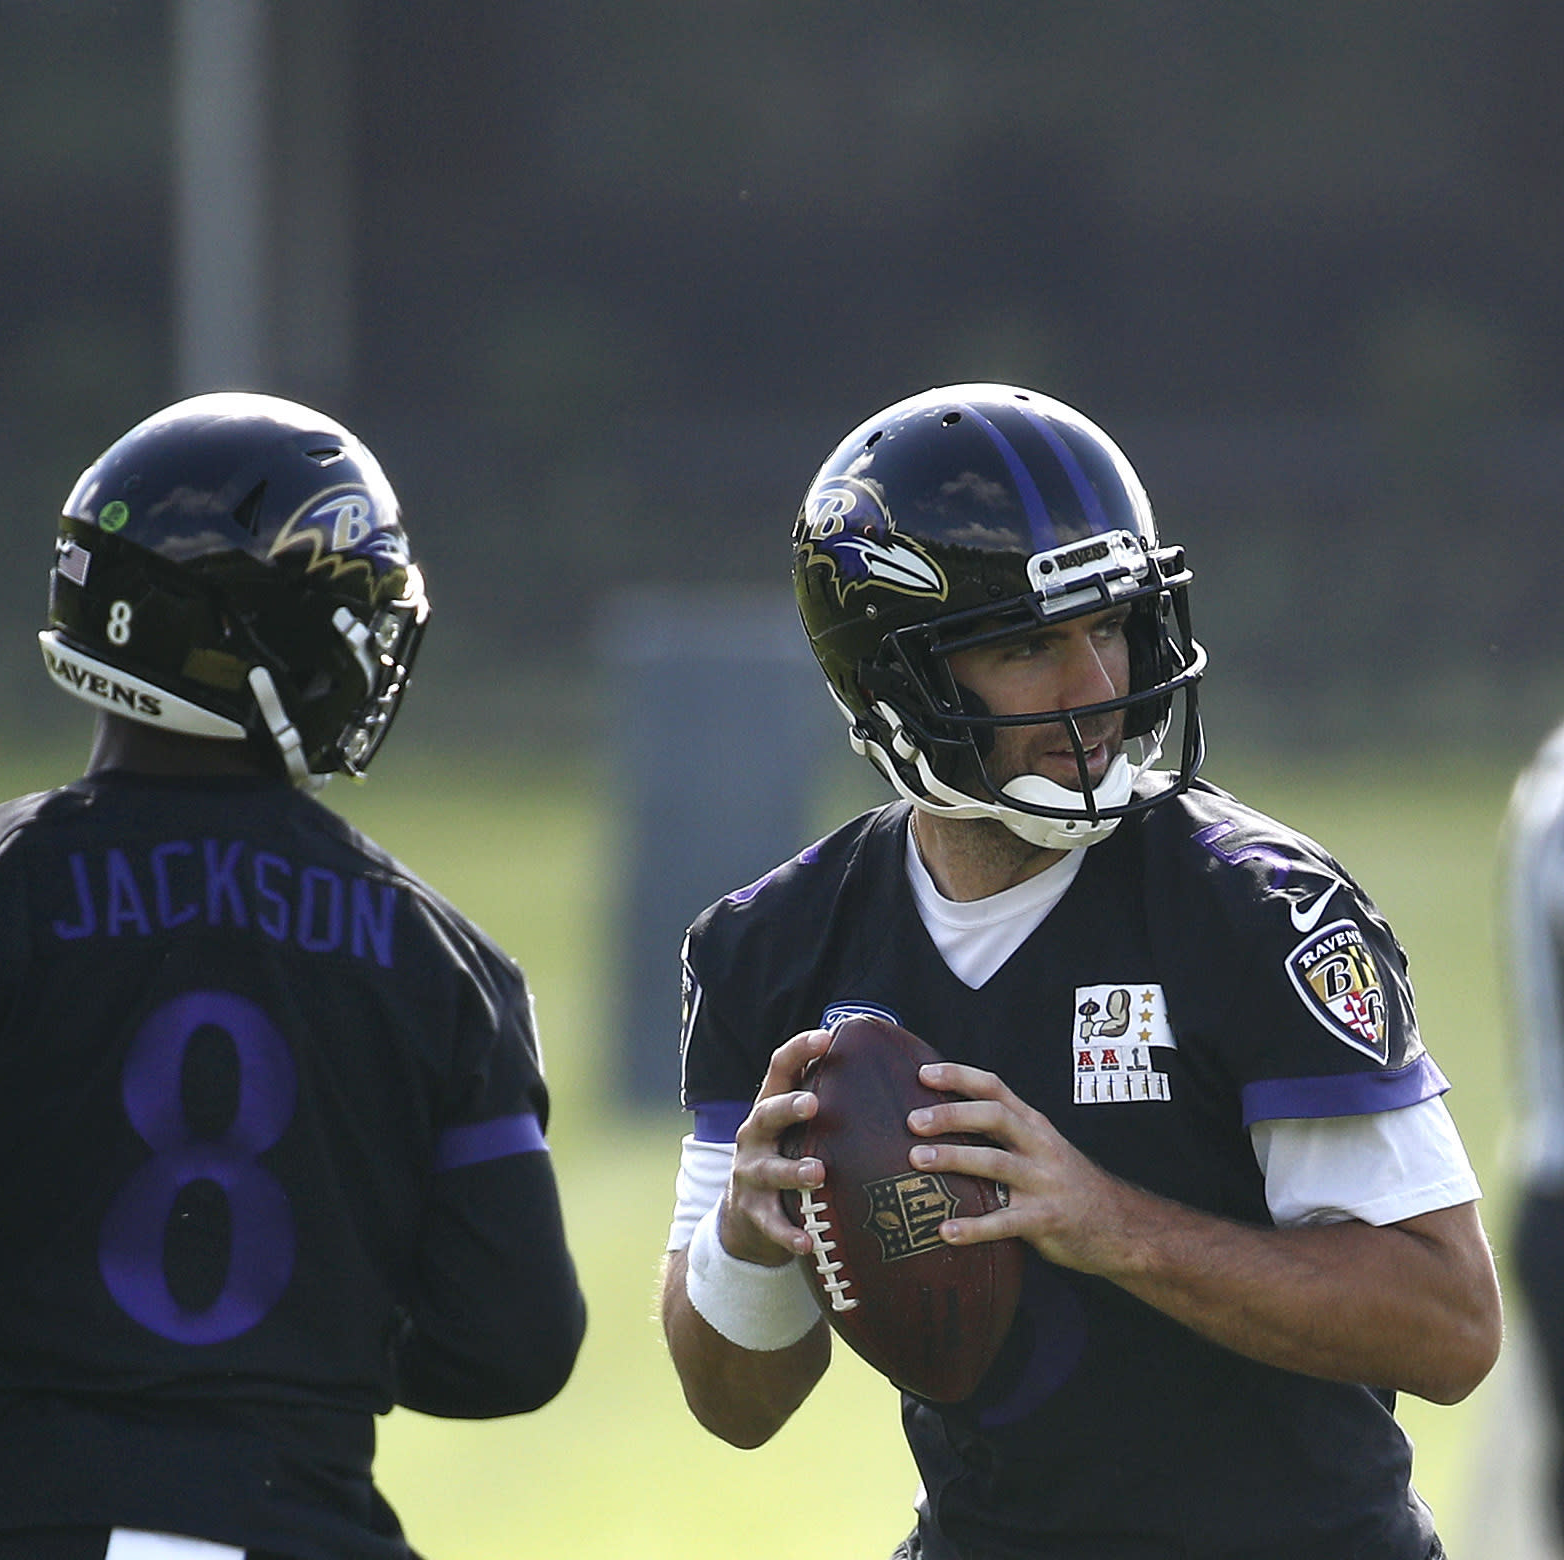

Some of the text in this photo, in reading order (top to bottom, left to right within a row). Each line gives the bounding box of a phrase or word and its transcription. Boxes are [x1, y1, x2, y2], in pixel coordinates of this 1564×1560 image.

[106, 600, 133, 645] 8
[52, 838, 397, 968] JACKSON
[96, 988, 299, 1347] 8
